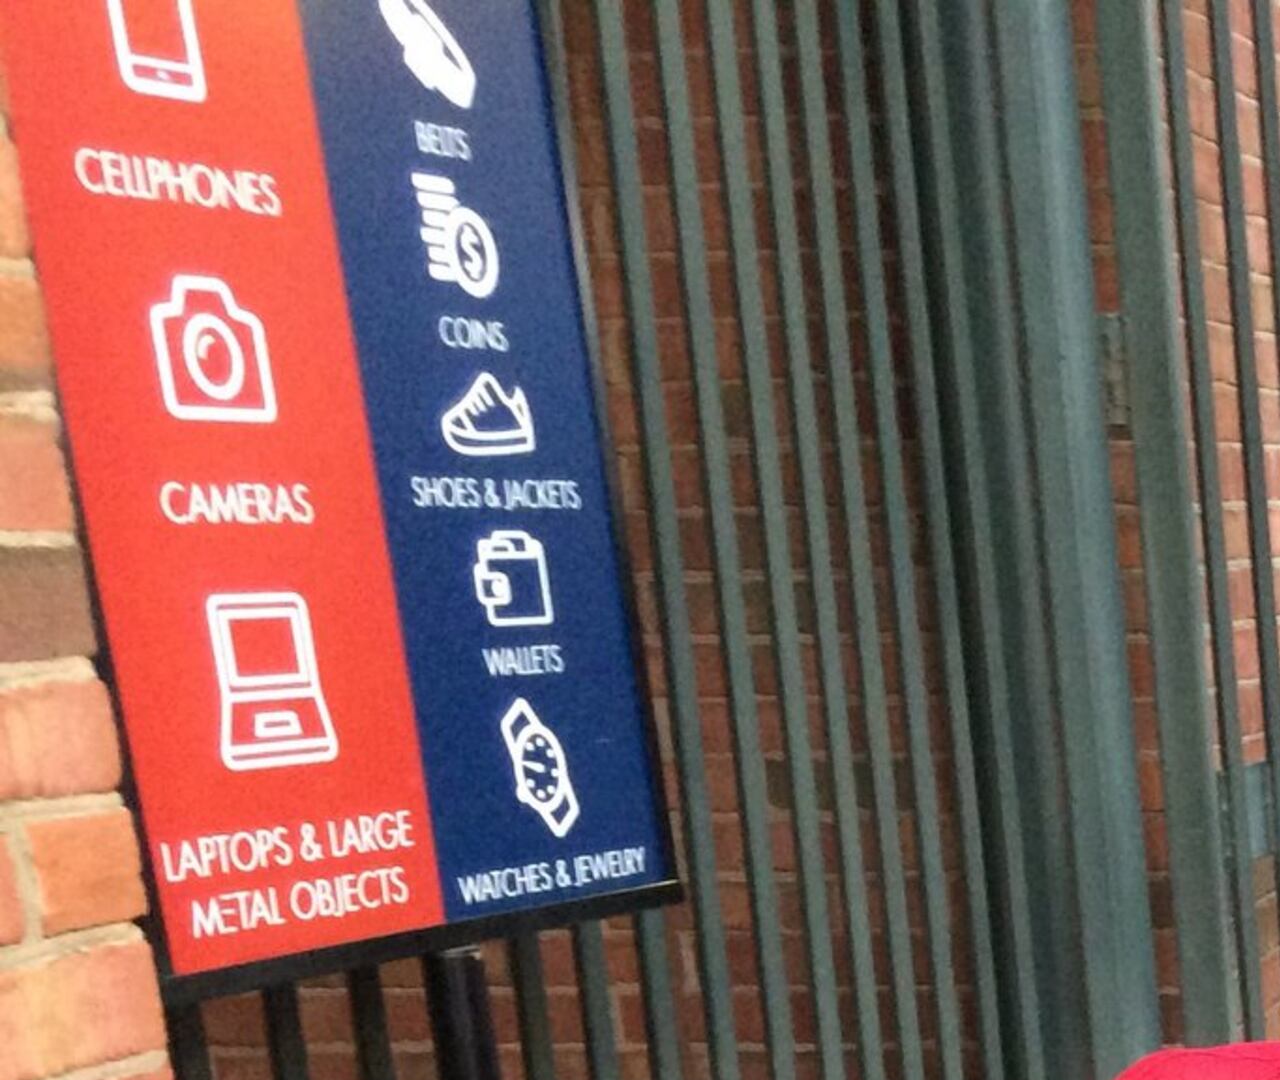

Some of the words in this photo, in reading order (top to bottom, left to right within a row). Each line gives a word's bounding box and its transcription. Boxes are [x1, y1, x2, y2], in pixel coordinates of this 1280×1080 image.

[74, 148, 282, 217] CELLPHONES
[159, 481, 314, 525] CAMERAS
[411, 475, 481, 509] SHOES
[483, 477, 501, 509] &
[503, 478, 582, 511] JACKETS
[483, 644, 563, 676] WALLETS
[160, 825, 293, 883] LAPTOPS
[300, 822, 324, 862] &
[327, 809, 415, 858] LARGE
[457, 862, 553, 905] WATCHES
[555, 859, 572, 887] &
[573, 846, 646, 887] JEWELRY
[191, 886, 286, 939] METAL
[290, 865, 409, 920] OBJECTS
